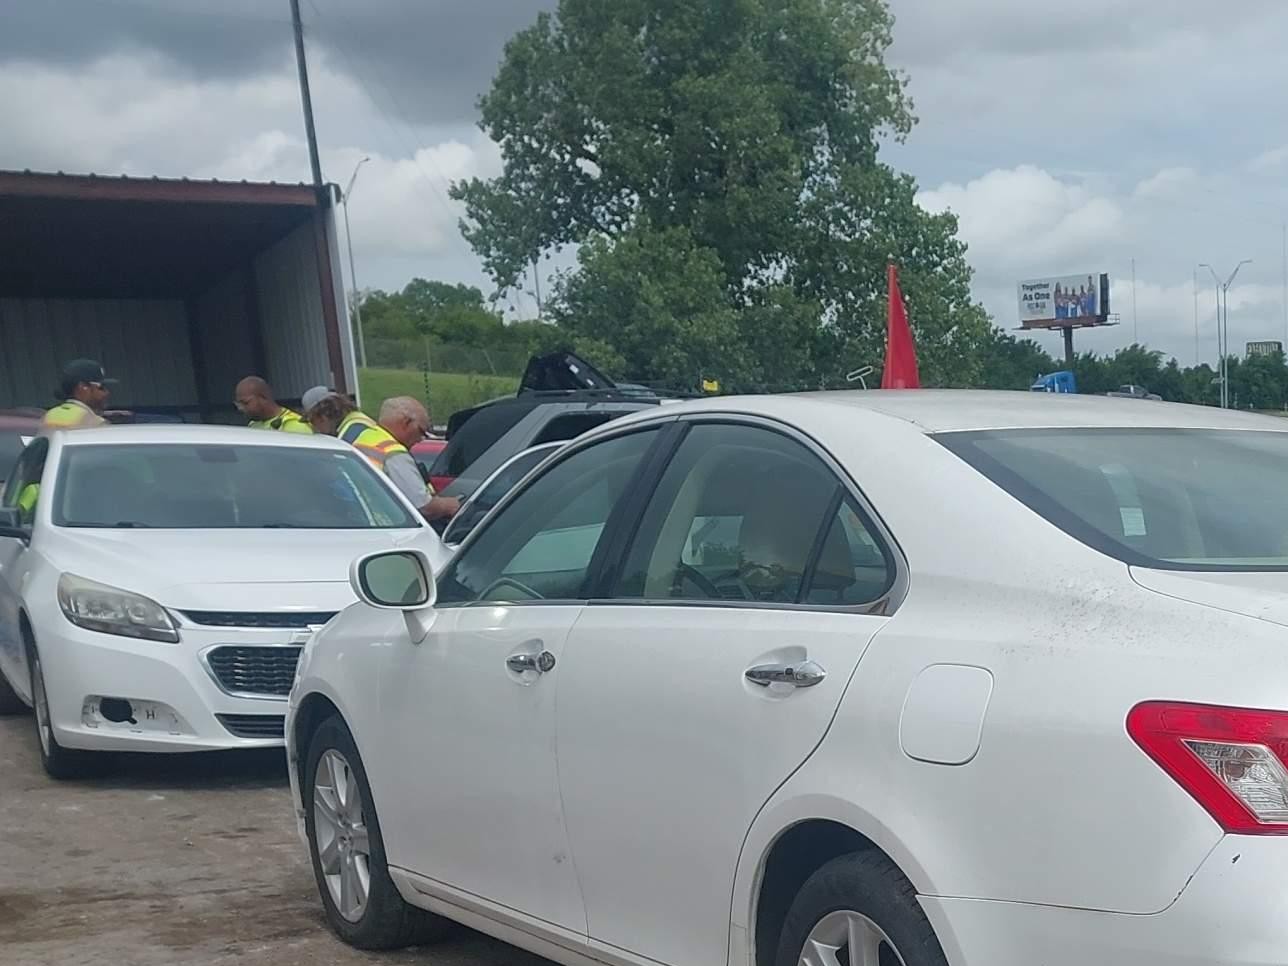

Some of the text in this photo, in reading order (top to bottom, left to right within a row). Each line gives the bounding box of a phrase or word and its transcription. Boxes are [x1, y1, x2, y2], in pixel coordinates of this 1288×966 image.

[1022, 283, 1049, 291] Together
[1023, 292, 1050, 301] As One
